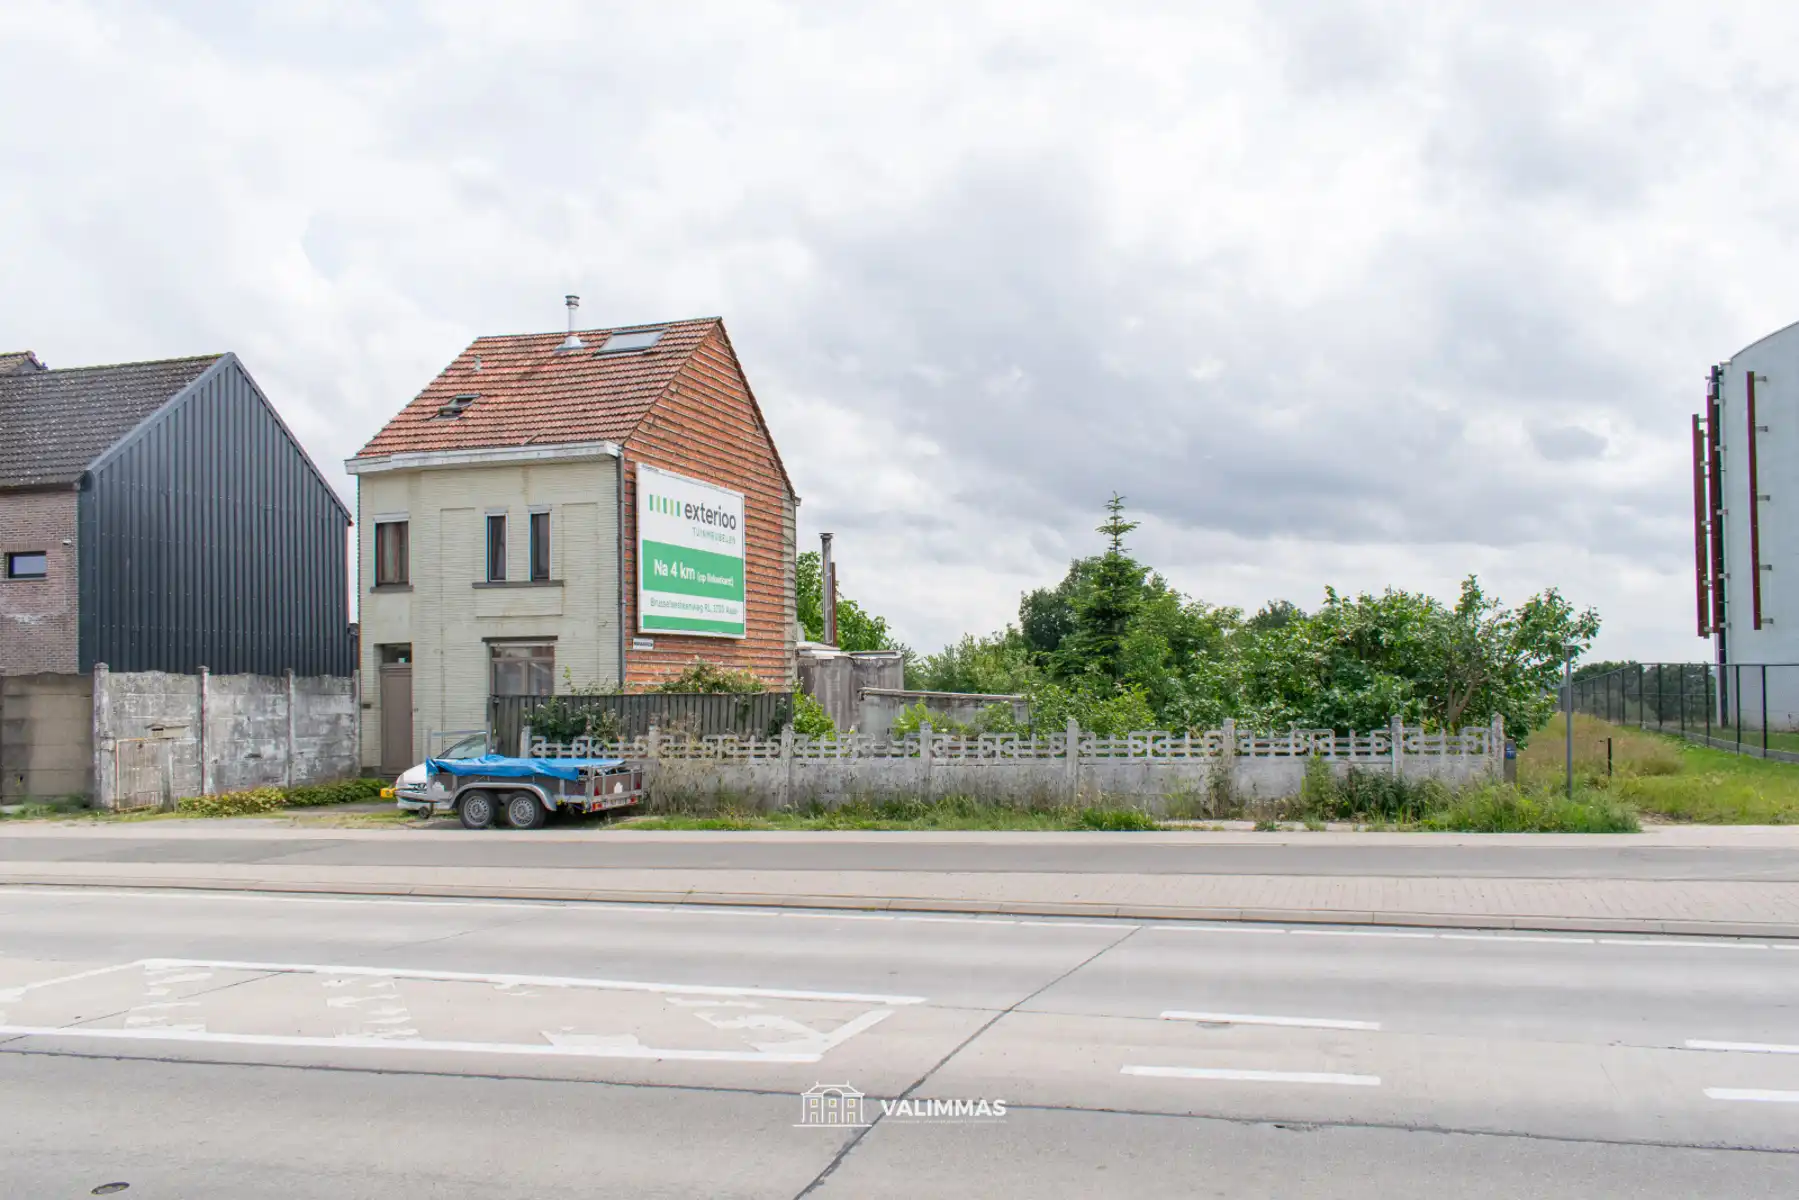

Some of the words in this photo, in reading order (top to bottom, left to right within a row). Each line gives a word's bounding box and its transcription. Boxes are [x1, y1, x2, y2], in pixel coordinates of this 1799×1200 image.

[685, 502, 736, 530] exterioo
[654, 558, 668, 577] Na
[670, 561, 678, 578] 4
[680, 561, 695, 580] km
